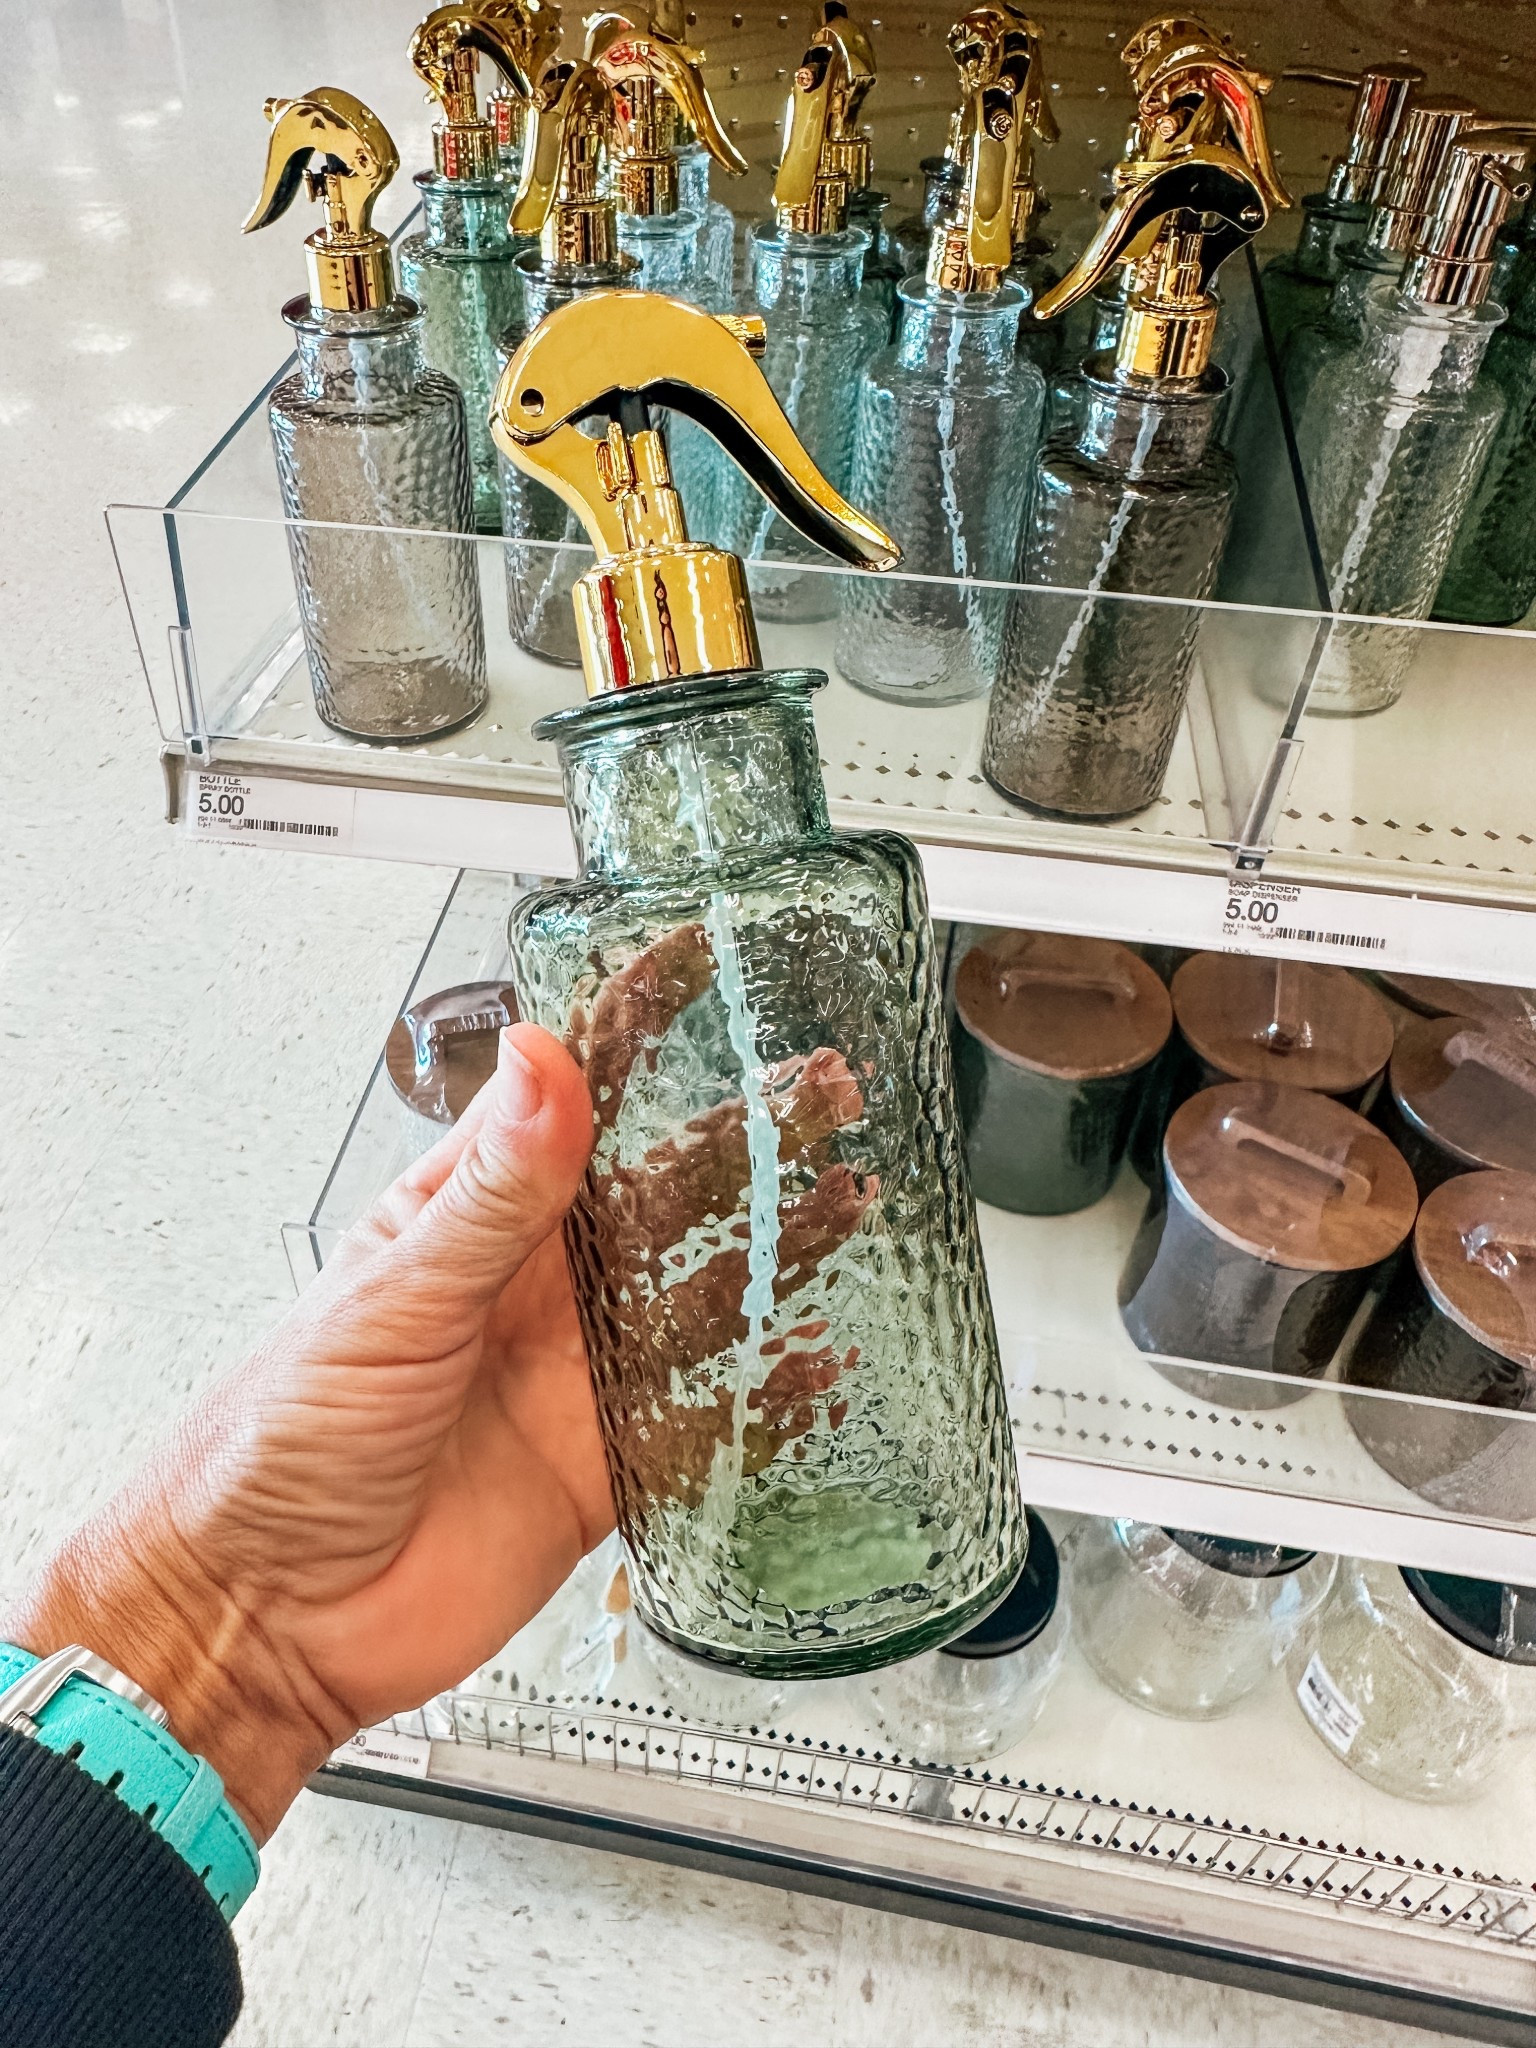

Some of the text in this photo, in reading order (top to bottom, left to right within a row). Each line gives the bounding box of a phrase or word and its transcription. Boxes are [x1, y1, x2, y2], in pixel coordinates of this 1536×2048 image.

[224, 786, 250, 794] BOTTLE
[199, 793, 244, 815] 5.00
[1252, 891, 1298, 902] DISPENSER
[1225, 898, 1279, 924] 5.00
